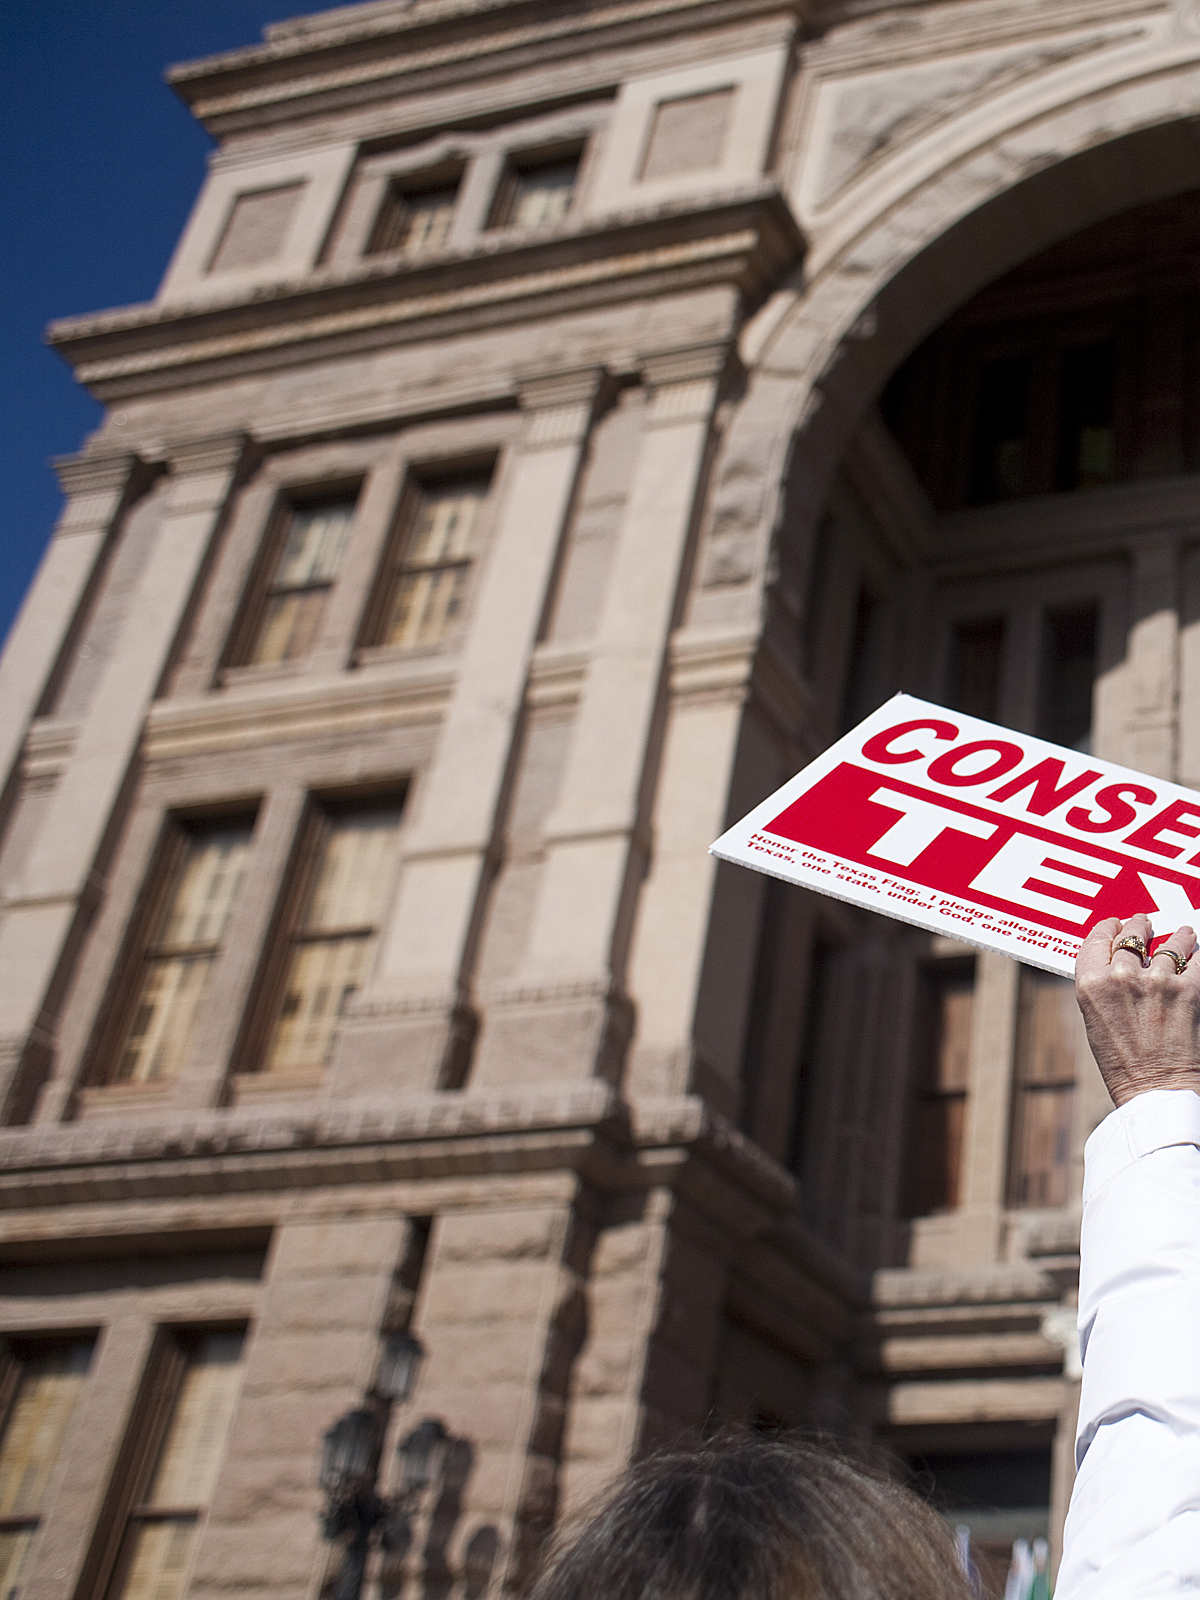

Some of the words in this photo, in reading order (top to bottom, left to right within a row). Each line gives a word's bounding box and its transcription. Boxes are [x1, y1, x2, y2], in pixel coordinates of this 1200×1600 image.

[747, 841, 796, 864] Texas,
[801, 861, 832, 875] one
[835, 873, 881, 893] state,
[887, 891, 935, 910] under
[939, 908, 975, 926] God,
[981, 923, 1012, 937] one
[1016, 934, 1049, 949] and
[1052, 945, 1079, 959] ind
[750, 833, 798, 853] Honor
[802, 851, 827, 863] the
[833, 861, 877, 881] Texas
[881, 878, 921, 896] Flag:
[938, 899, 994, 921] pledge
[998, 918, 1082, 949] allegiance
